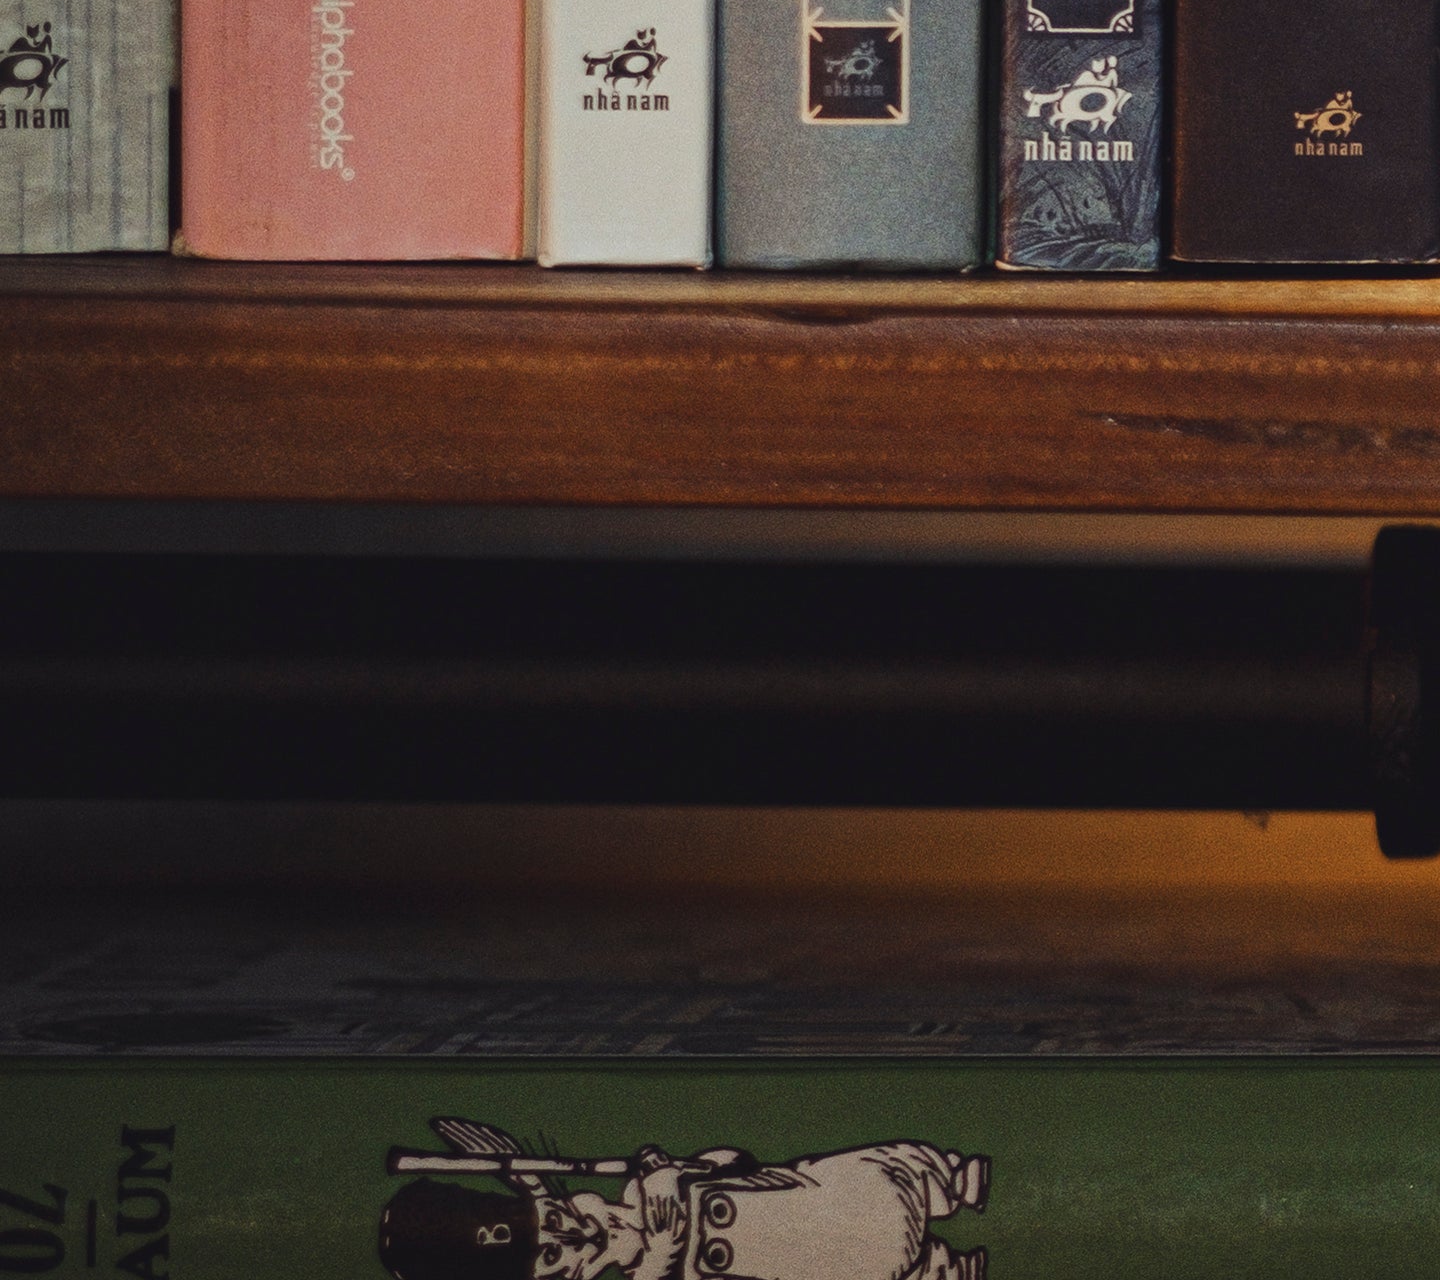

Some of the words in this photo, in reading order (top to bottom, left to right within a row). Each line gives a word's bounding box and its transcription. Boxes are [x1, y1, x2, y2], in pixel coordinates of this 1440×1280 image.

[628, 87, 670, 112] nam
[1080, 137, 1133, 161] nam
[1331, 138, 1363, 156] nam
